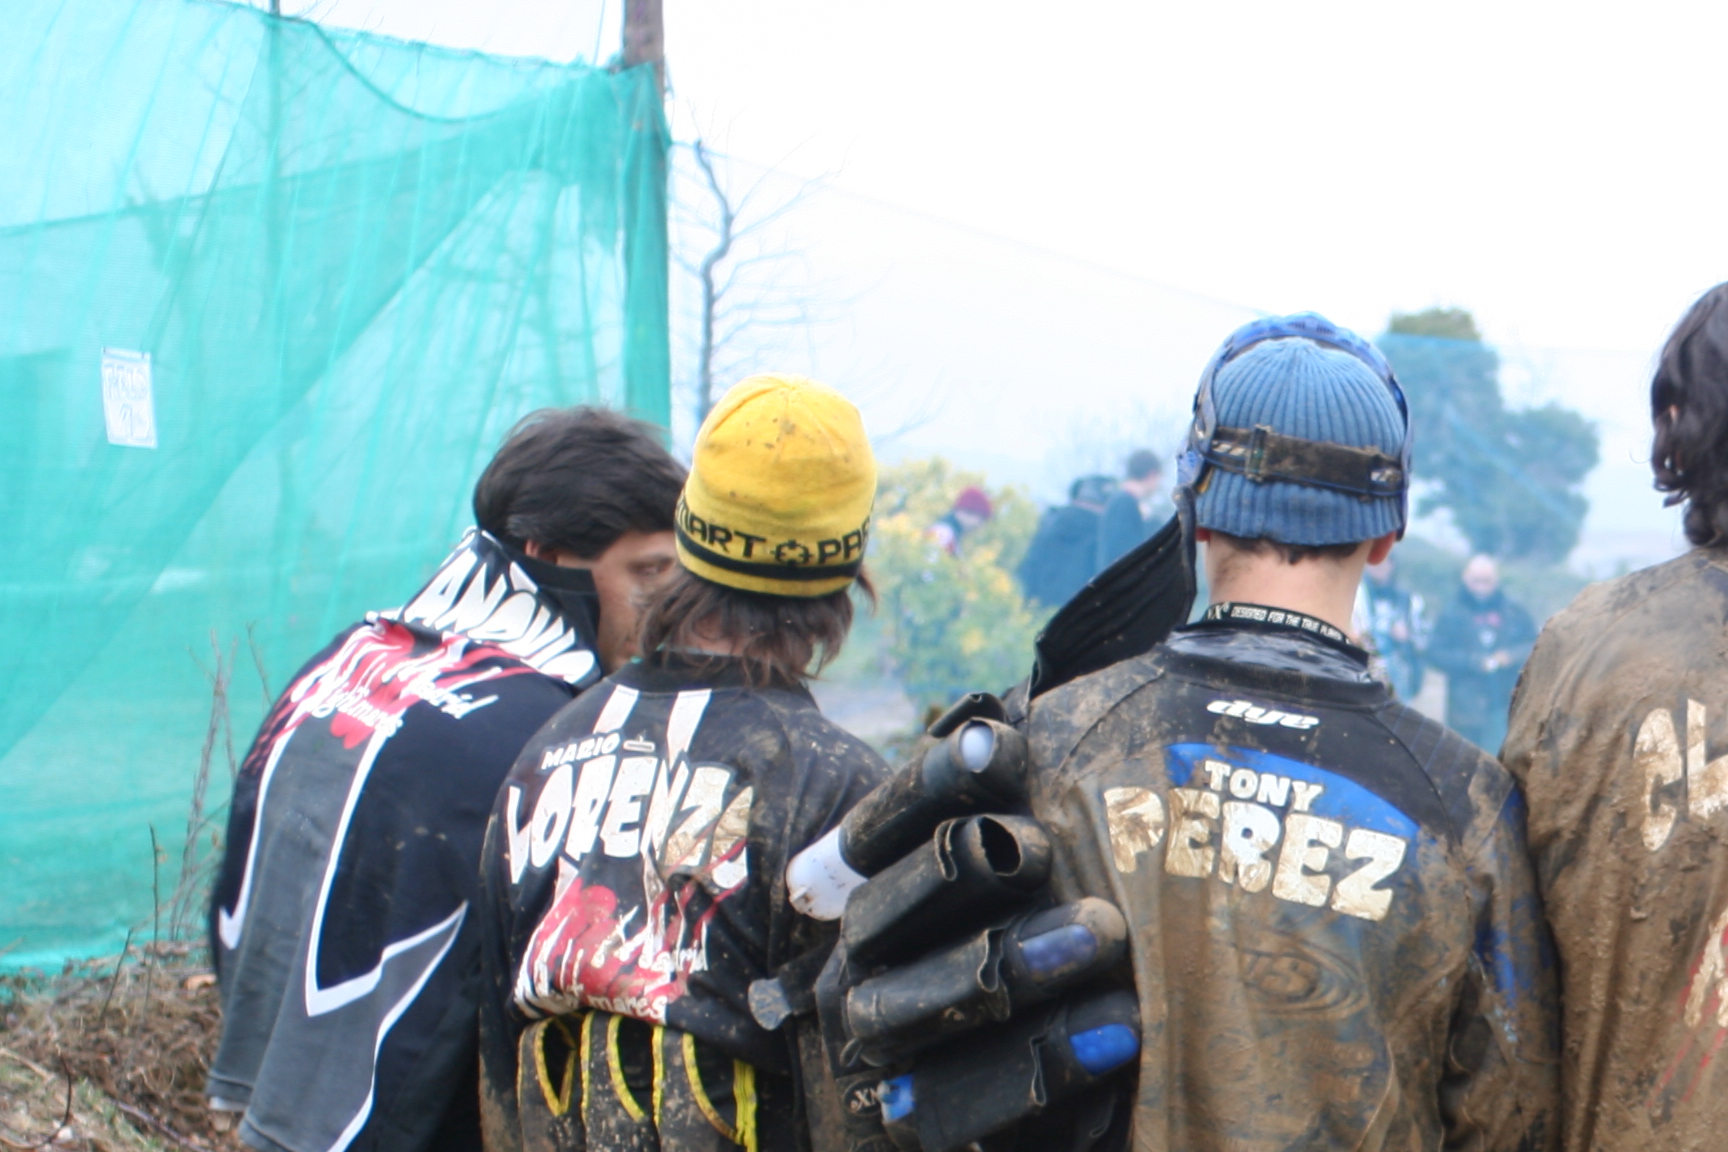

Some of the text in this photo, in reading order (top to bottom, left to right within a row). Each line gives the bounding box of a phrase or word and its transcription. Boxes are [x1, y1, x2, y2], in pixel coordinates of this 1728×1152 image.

[677, 500, 766, 559] MART
[541, 732, 620, 770] MARIO
[1205, 760, 1324, 811] TONY
[507, 754, 754, 889] LORENZO
[1104, 787, 1406, 922] PEREZ
